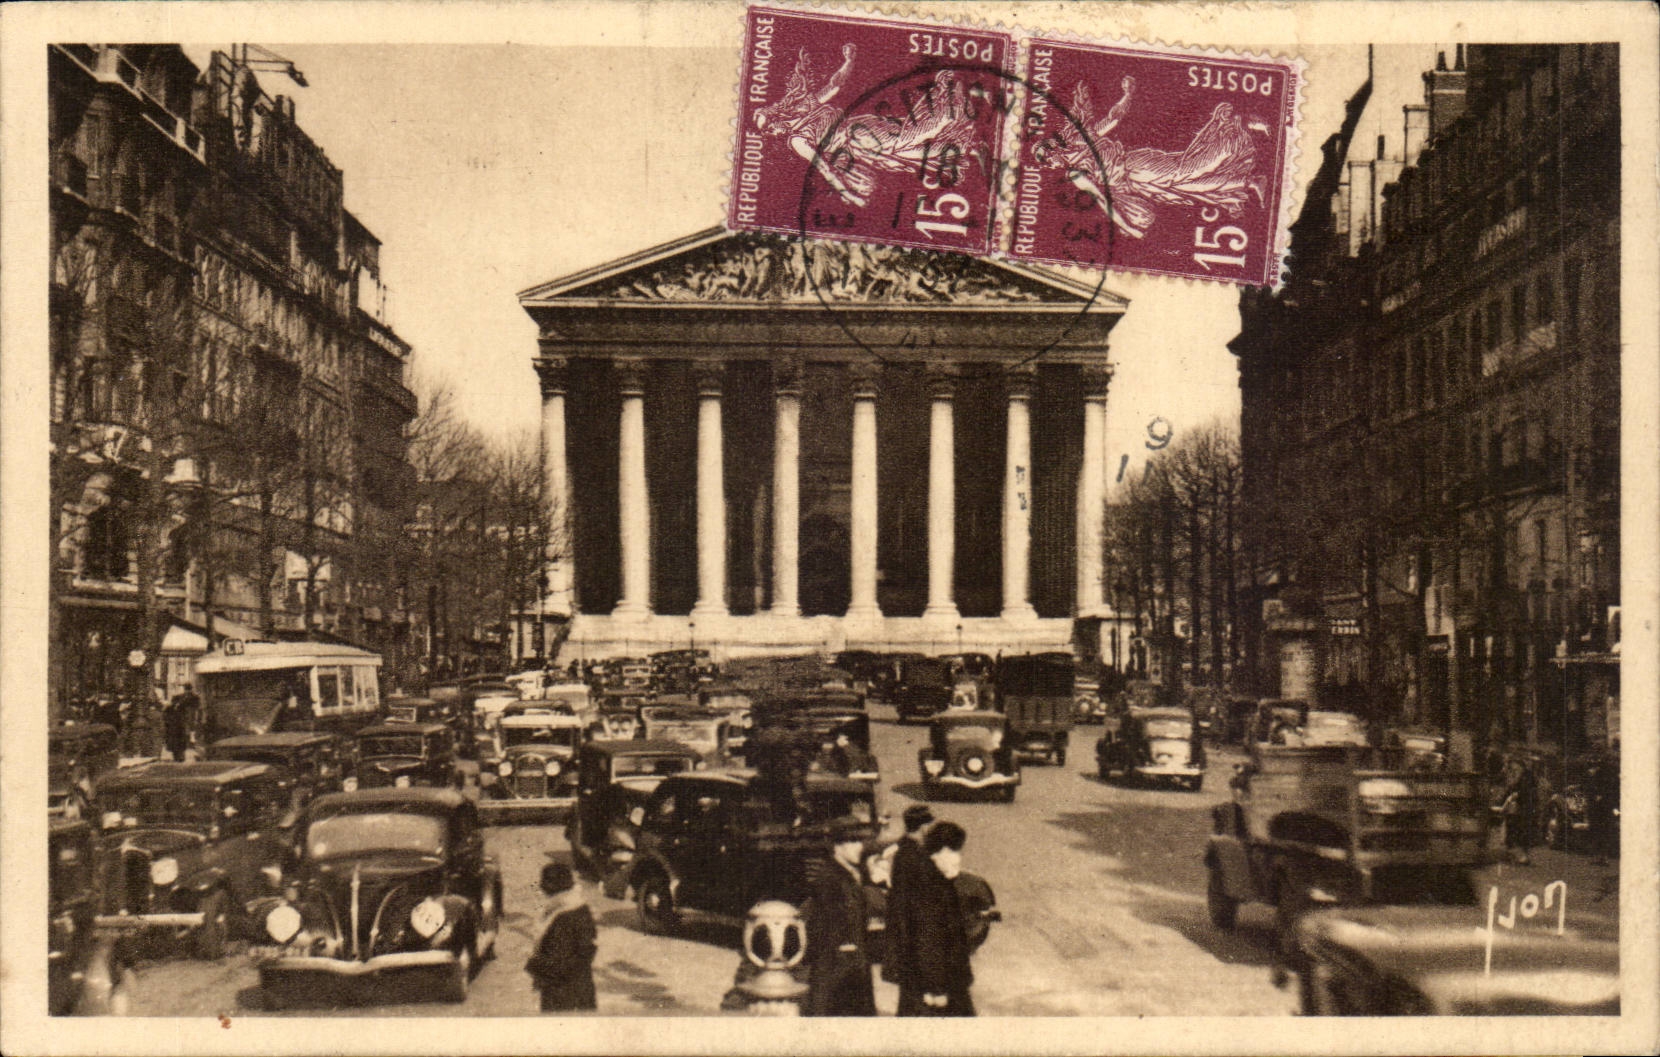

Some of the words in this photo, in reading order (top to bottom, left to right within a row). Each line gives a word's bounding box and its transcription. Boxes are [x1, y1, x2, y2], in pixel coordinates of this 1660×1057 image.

[909, 33, 993, 62] POSTES
[1188, 66, 1273, 95] POSTES
[736, 131, 764, 223] REPUBLIQUE
[750, 17, 775, 103] FRANÇAISE
[813, 80, 1016, 228] EPOSITION
